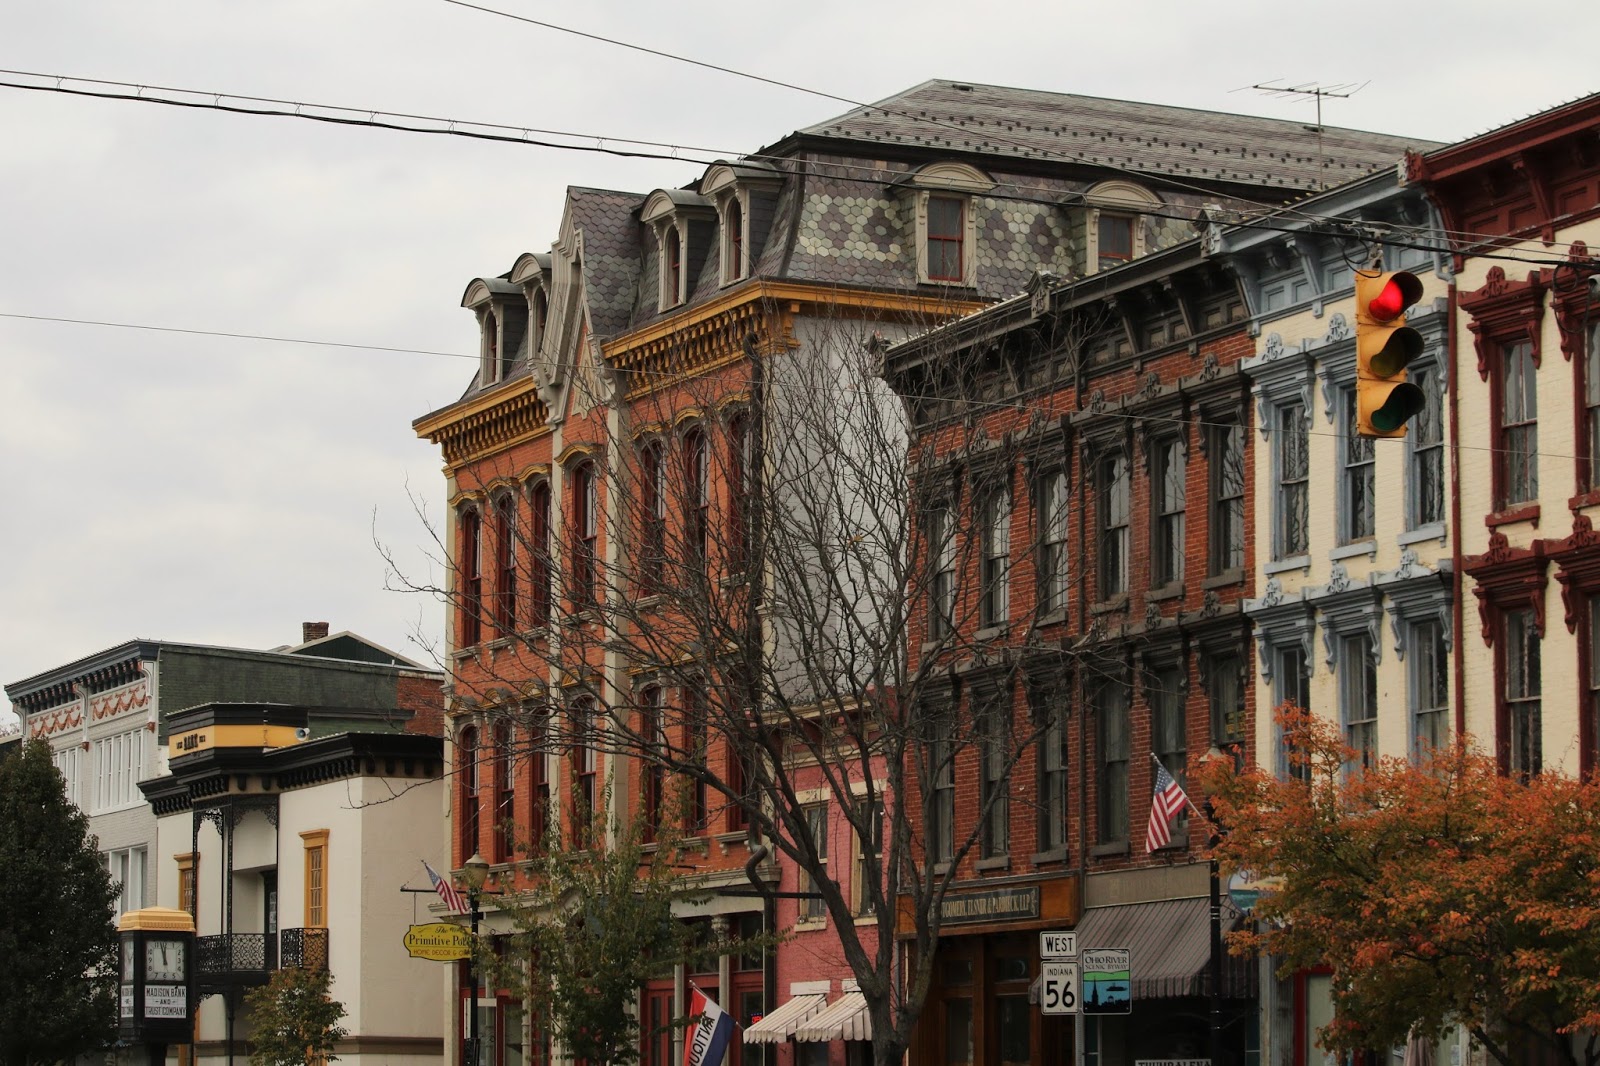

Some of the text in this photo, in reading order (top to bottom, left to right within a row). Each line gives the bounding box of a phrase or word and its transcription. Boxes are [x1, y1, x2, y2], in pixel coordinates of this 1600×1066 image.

[1020, 894, 1030, 911] LLP
[409, 934, 451, 946] Primitive
[1046, 937, 1073, 953] WEST
[1085, 956, 1127, 964] OHIO RIVER
[1047, 968, 1073, 976] INDIANA
[146, 988, 186, 998] MADISON BANK
[1046, 980, 1075, 1008] 56
[145, 1006, 187, 1016] TRUST COMPANY
